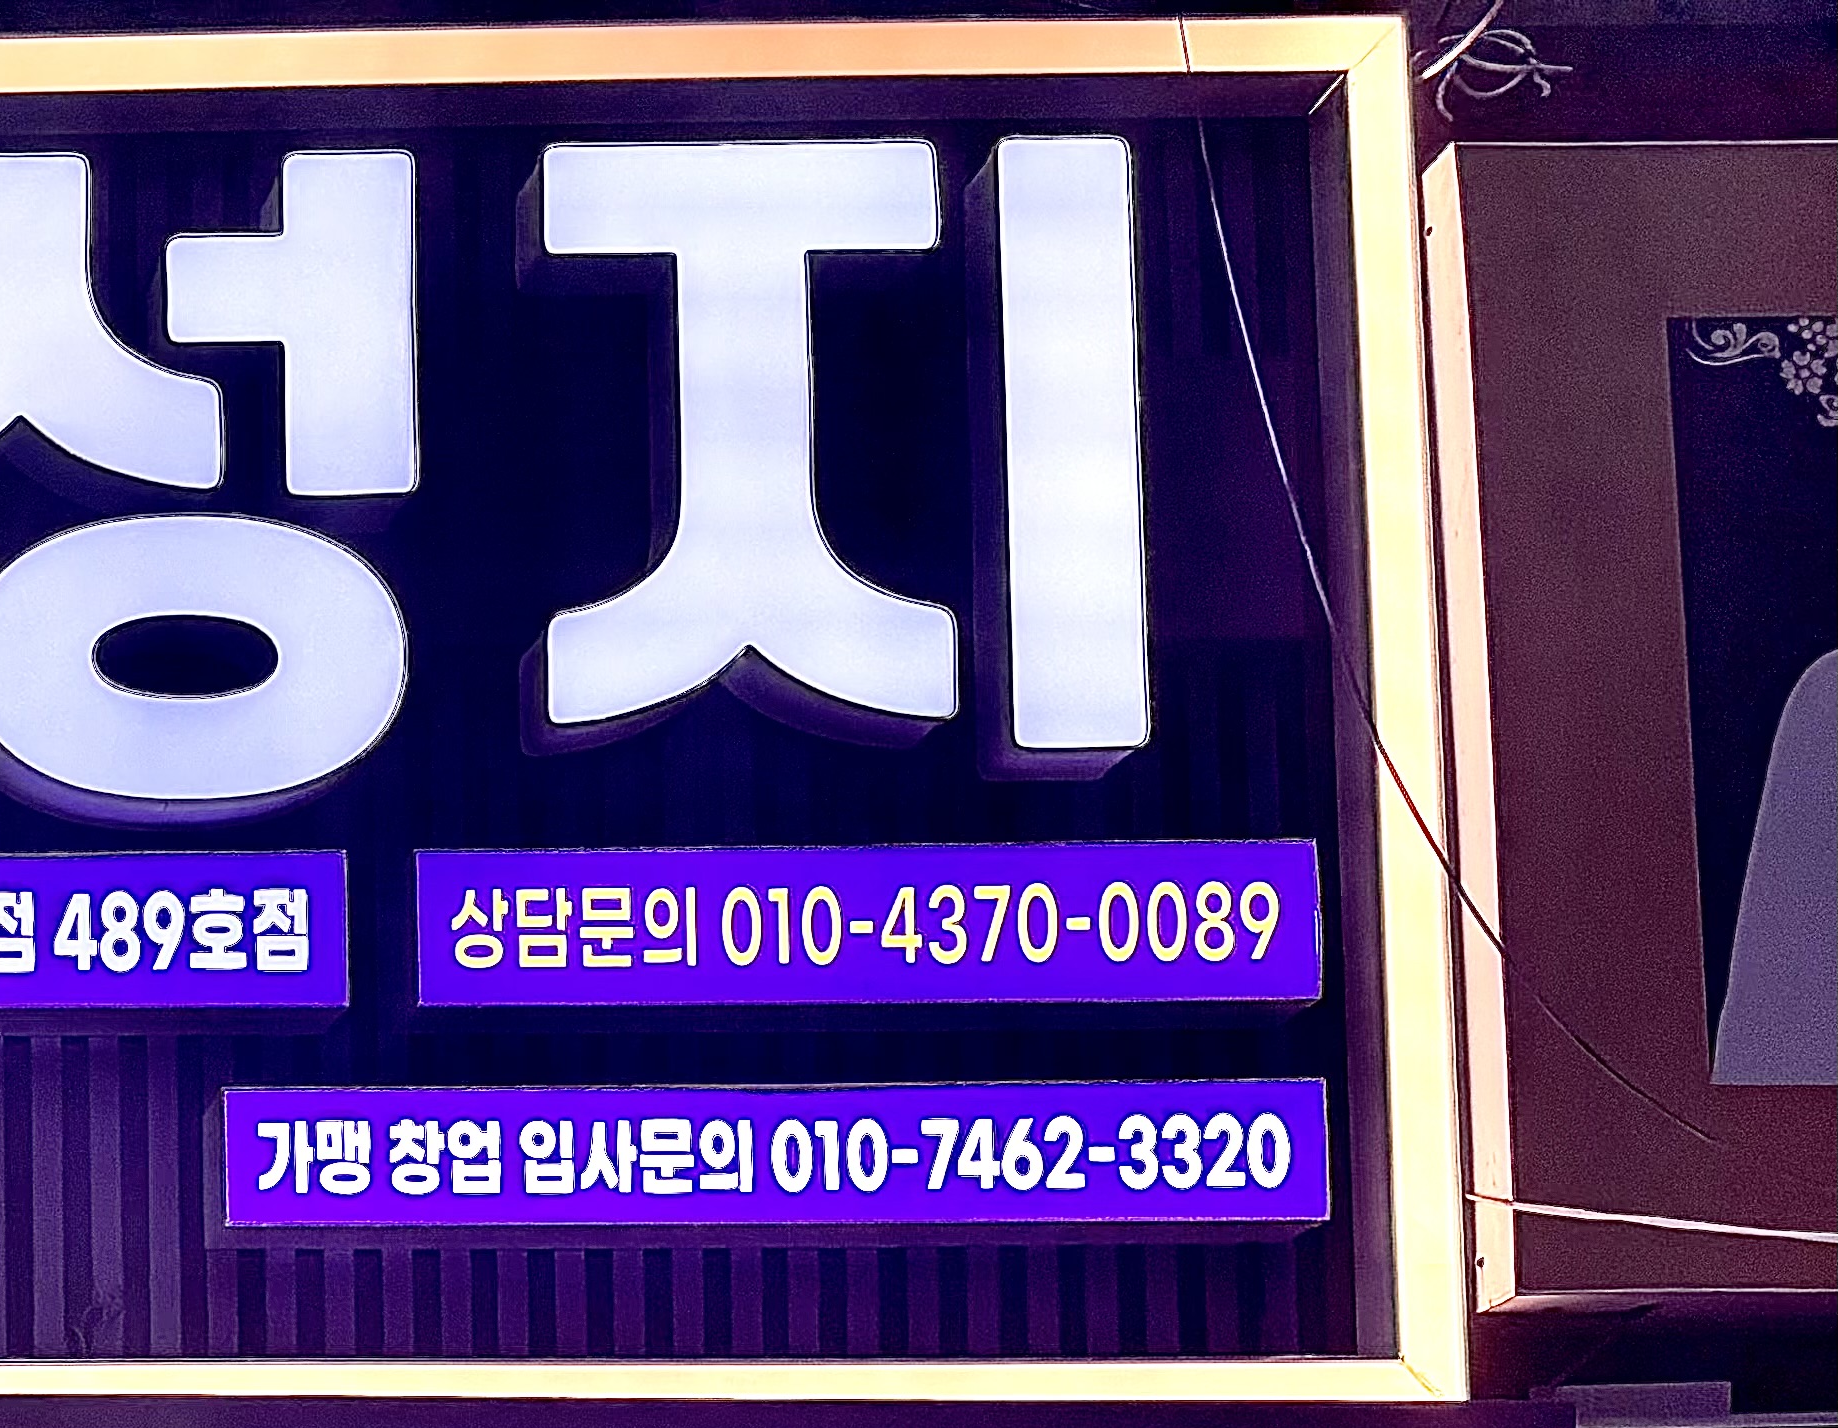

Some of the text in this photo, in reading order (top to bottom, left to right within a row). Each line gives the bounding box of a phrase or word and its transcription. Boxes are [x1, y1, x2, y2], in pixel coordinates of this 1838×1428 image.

[53, 887, 312, 976] 489호점
[448, 880, 1280, 973] 상담문의 010-4370-0089
[255, 1109, 1292, 1199] 가맹 창업 입사문의 010-7462-3320
